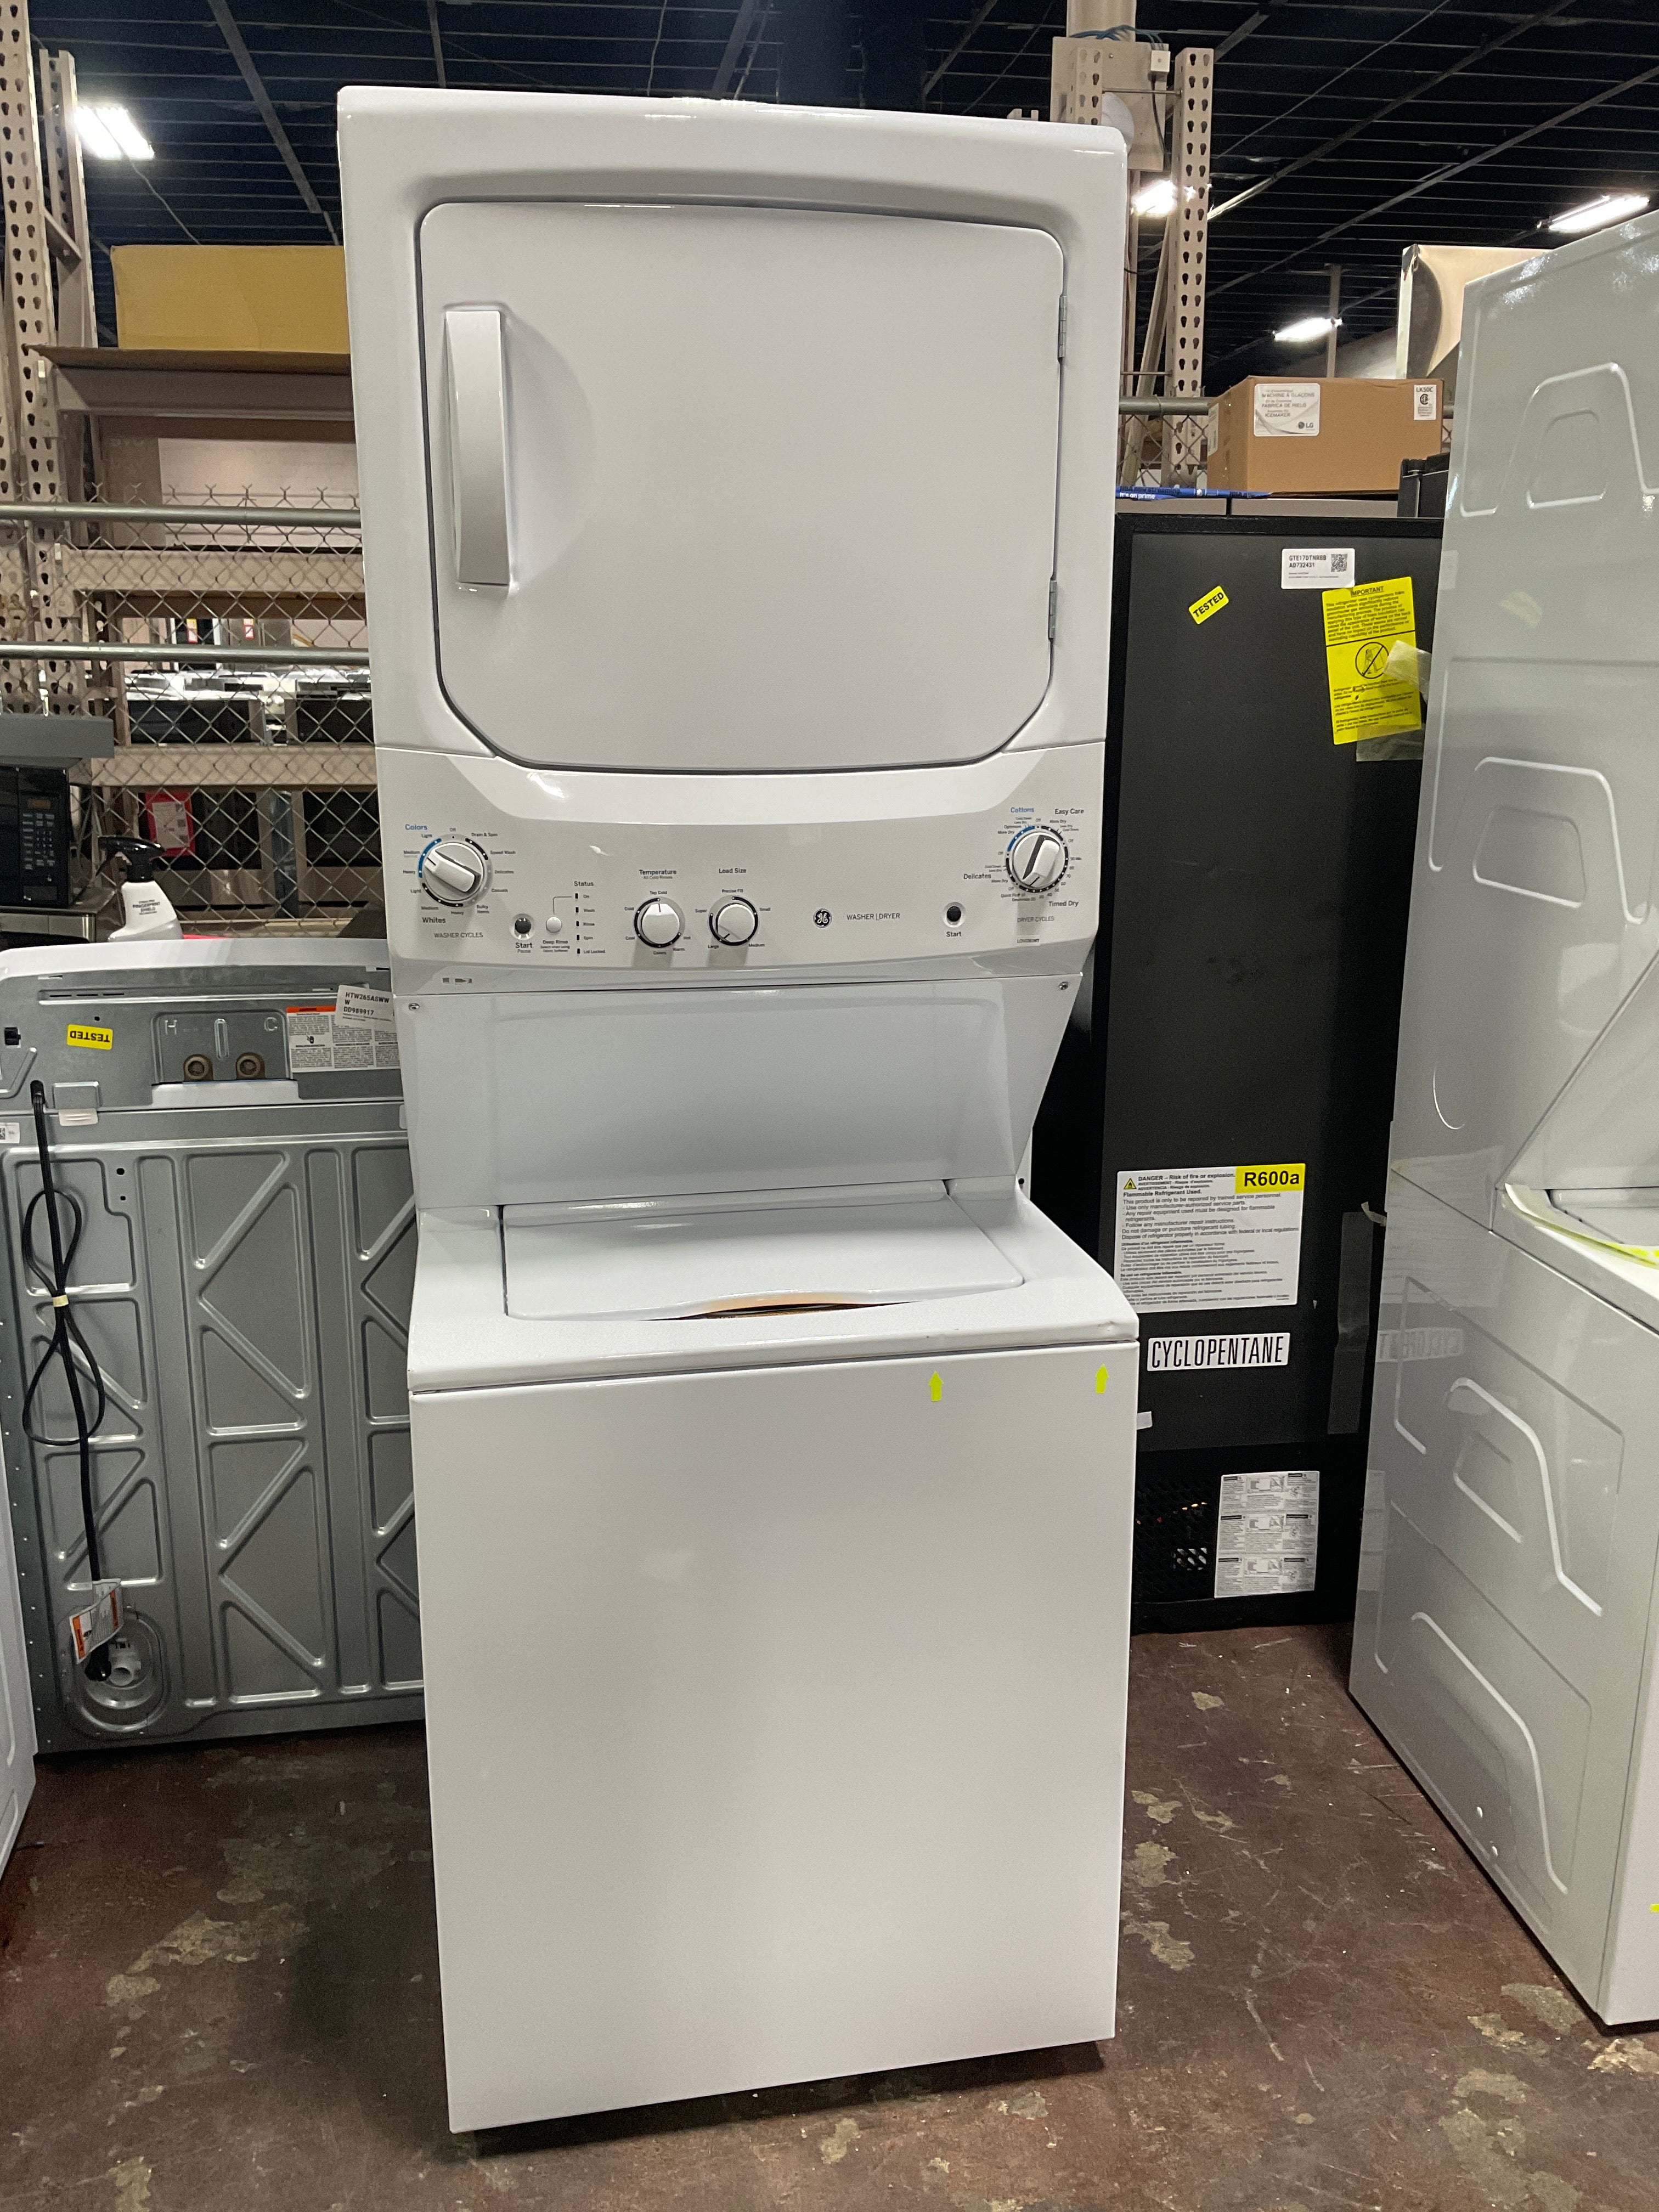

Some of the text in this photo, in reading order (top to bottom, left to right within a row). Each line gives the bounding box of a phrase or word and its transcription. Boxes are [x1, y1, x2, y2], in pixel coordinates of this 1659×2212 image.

[1193, 592, 1224, 617] TESTED
[345, 991, 390, 1003] HTW265ASWW
[343, 1006, 374, 1015] DD989917
[70, 1030, 110, 1043] TESTED
[1244, 1170, 1300, 1187] R600a
[1152, 1336, 1284, 1368] CYCLOPENTANE
